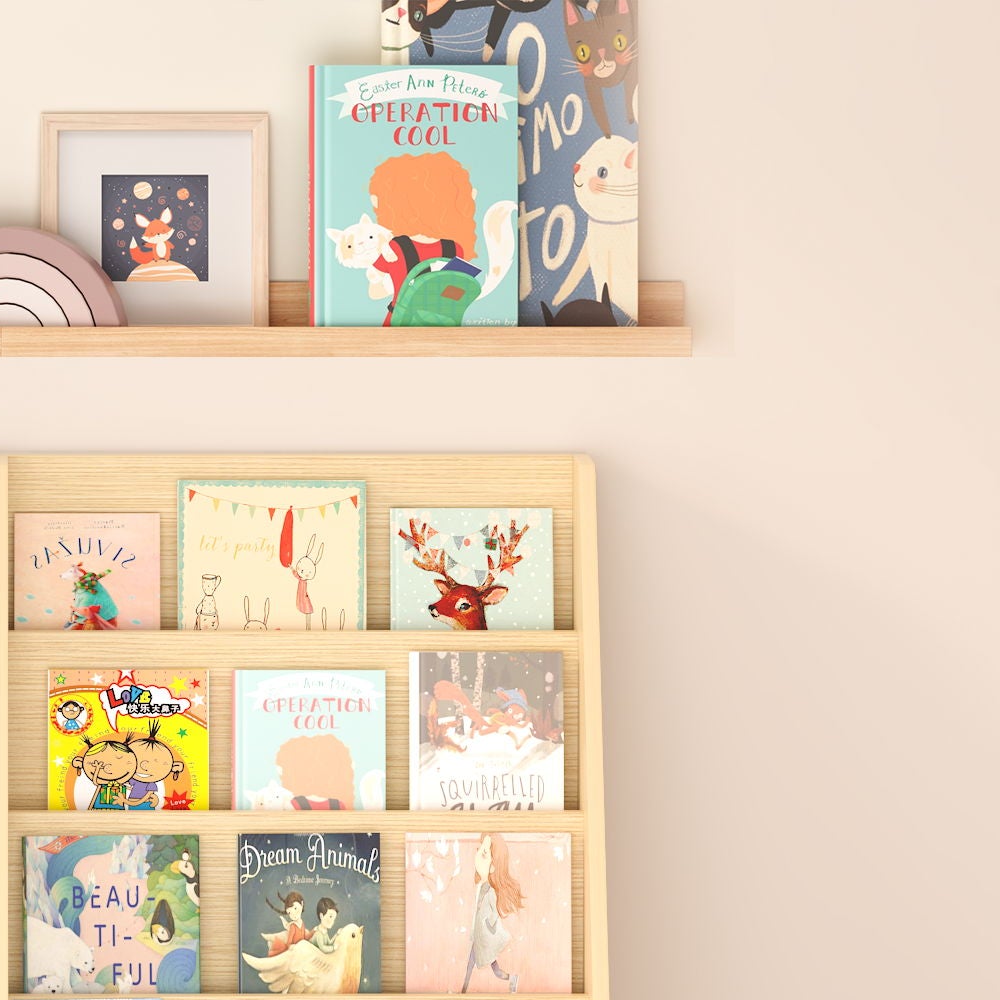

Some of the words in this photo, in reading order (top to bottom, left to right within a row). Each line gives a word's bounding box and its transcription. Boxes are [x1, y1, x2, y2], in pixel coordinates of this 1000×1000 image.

[351, 102, 498, 123] OPERATION
[393, 125, 456, 146] COOL
[262, 697, 371, 713] OPERATION
[293, 714, 340, 730] COOL
[439, 773, 545, 807] SQUIRRELLED
[169, 798, 187, 807] Love
[239, 839, 303, 884] Dream
[306, 833, 380, 883] Animals
[72, 885, 156, 909] BEAU-
[93, 924, 132, 947] TI-
[112, 963, 158, 986] FUL
